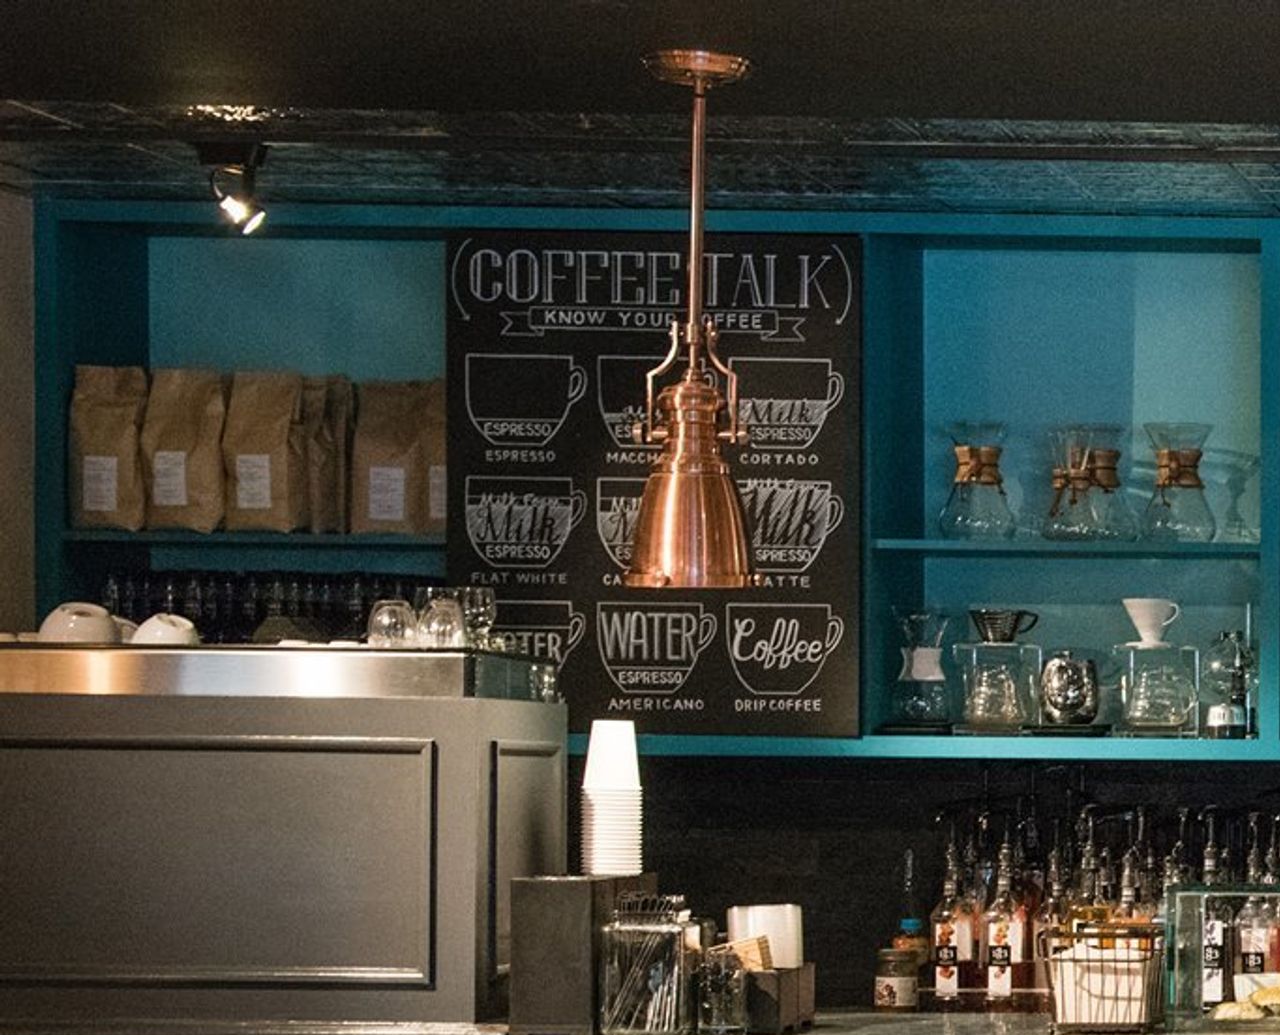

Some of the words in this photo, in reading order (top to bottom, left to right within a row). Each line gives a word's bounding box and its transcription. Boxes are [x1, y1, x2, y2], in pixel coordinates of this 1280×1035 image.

[469, 249, 681, 304] COFFEE
[703, 253, 833, 309] TALK
[544, 310, 605, 326] KNOW
[700, 313, 762, 330] OFFEE
[484, 421, 552, 438] ESPRESSO
[485, 449, 557, 464] ESPRESSO
[605, 451, 658, 465] MACCH
[740, 453, 820, 466] CORTADO
[485, 544, 551, 559] ESPRESSO
[754, 548, 812, 562] SPRESSO
[470, 572, 511, 585] FLAT
[515, 572, 568, 585] WHITE
[763, 574, 812, 589] ATTE
[600, 611, 699, 662] WATER
[732, 617, 824, 669] Coffee
[618, 671, 683, 685] ESPRESSO
[607, 698, 705, 712] AMERICANO
